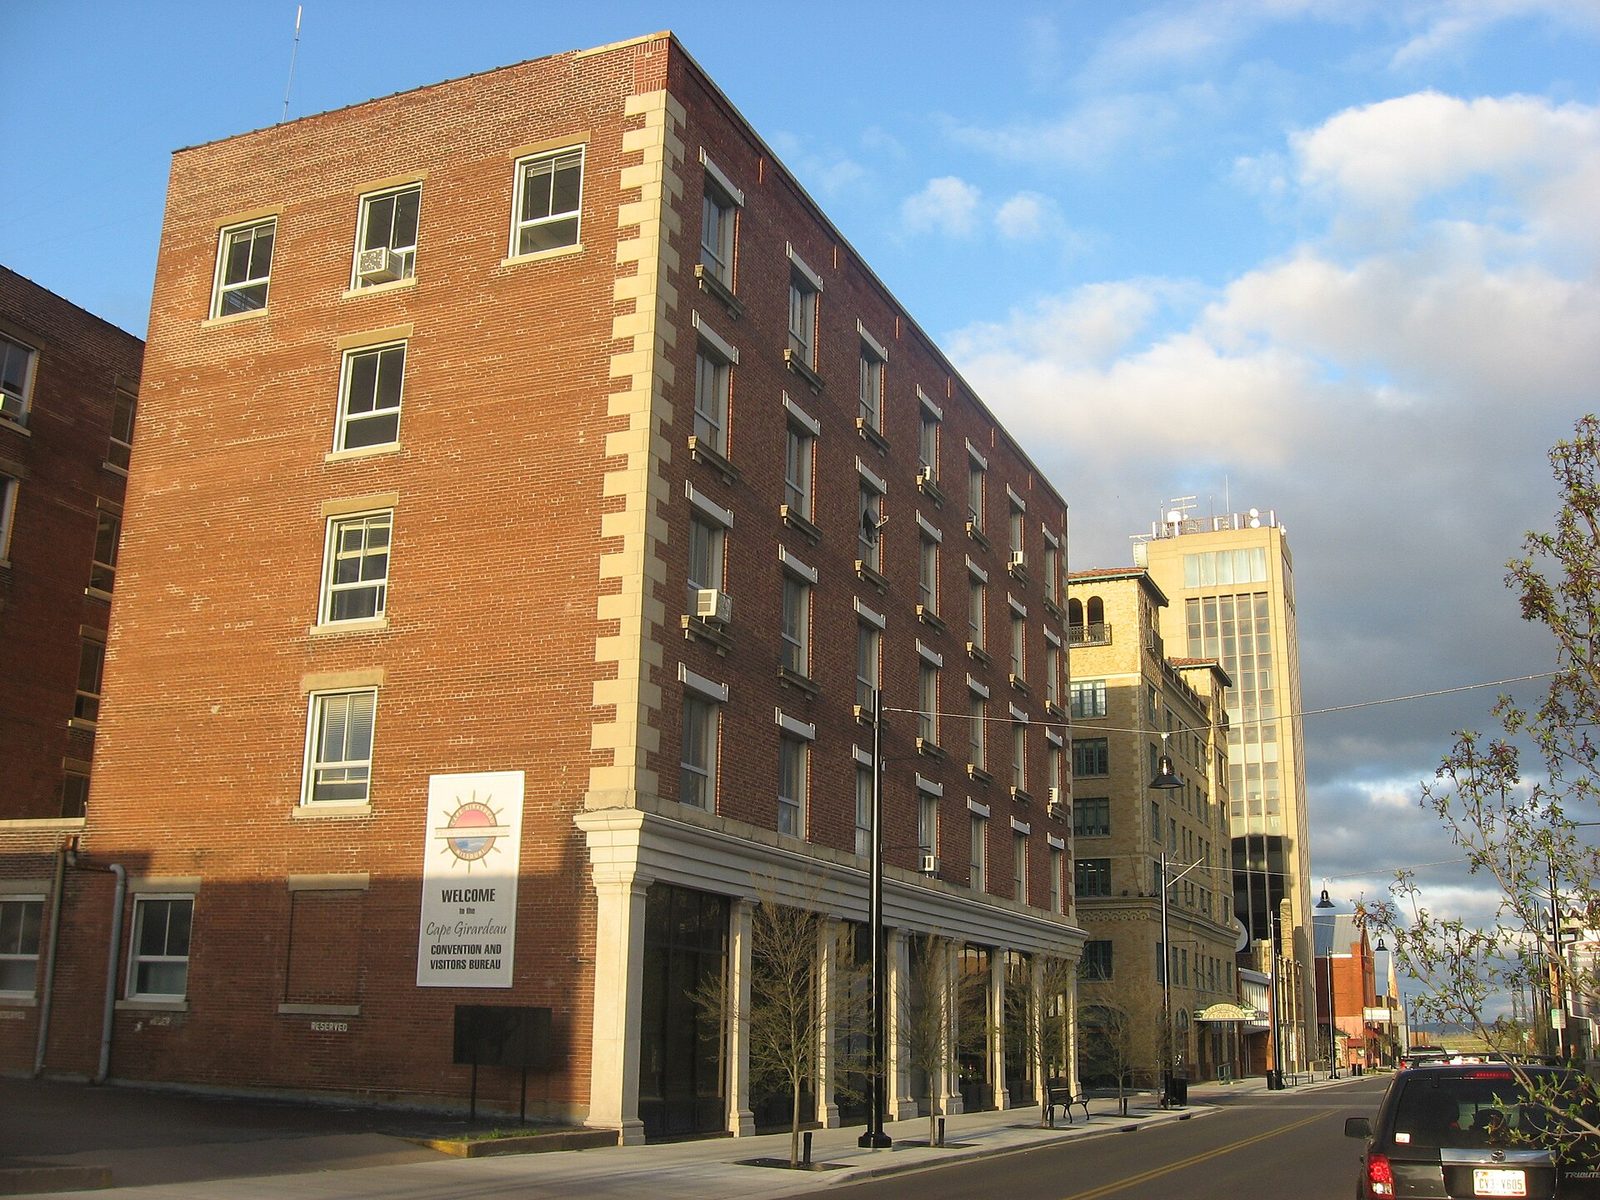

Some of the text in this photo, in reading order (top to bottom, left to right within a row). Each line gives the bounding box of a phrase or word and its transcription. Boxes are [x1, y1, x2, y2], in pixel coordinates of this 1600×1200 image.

[441, 888, 496, 903] WELCOME
[426, 917, 507, 943] Cape Girardeau
[430, 944, 502, 955] CONVENTION AND
[430, 959, 501, 970] VISITORS BUREAU
[311, 1021, 348, 1032] RESERVED
